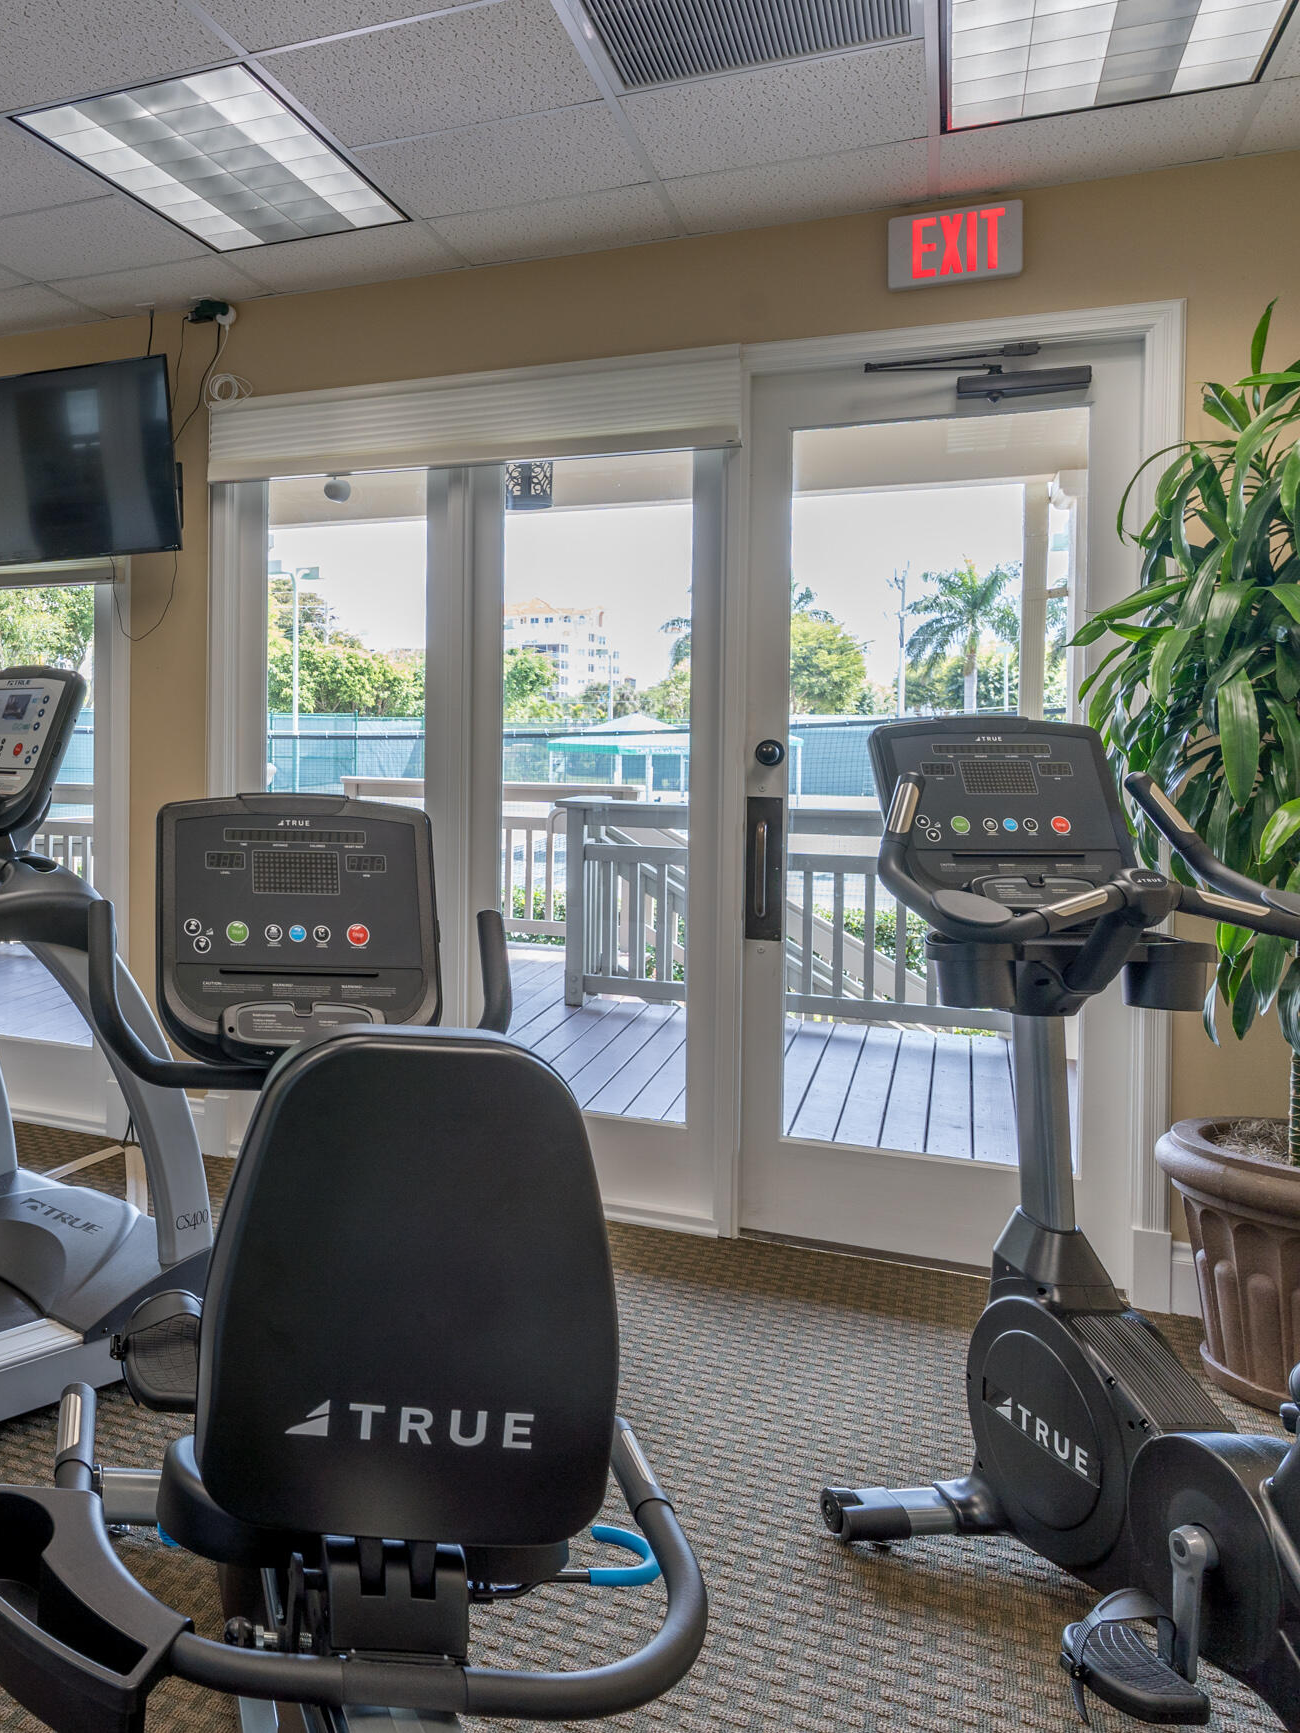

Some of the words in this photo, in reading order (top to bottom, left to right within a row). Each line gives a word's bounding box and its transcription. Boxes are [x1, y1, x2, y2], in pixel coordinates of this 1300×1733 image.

[912, 207, 1005, 279] EXIT
[285, 819, 311, 827] TRUE
[43, 1205, 104, 1235] TRUE
[175, 1208, 209, 1231] CS400
[350, 1403, 533, 1450] TRUE
[1017, 1404, 1090, 1476] TRUE
